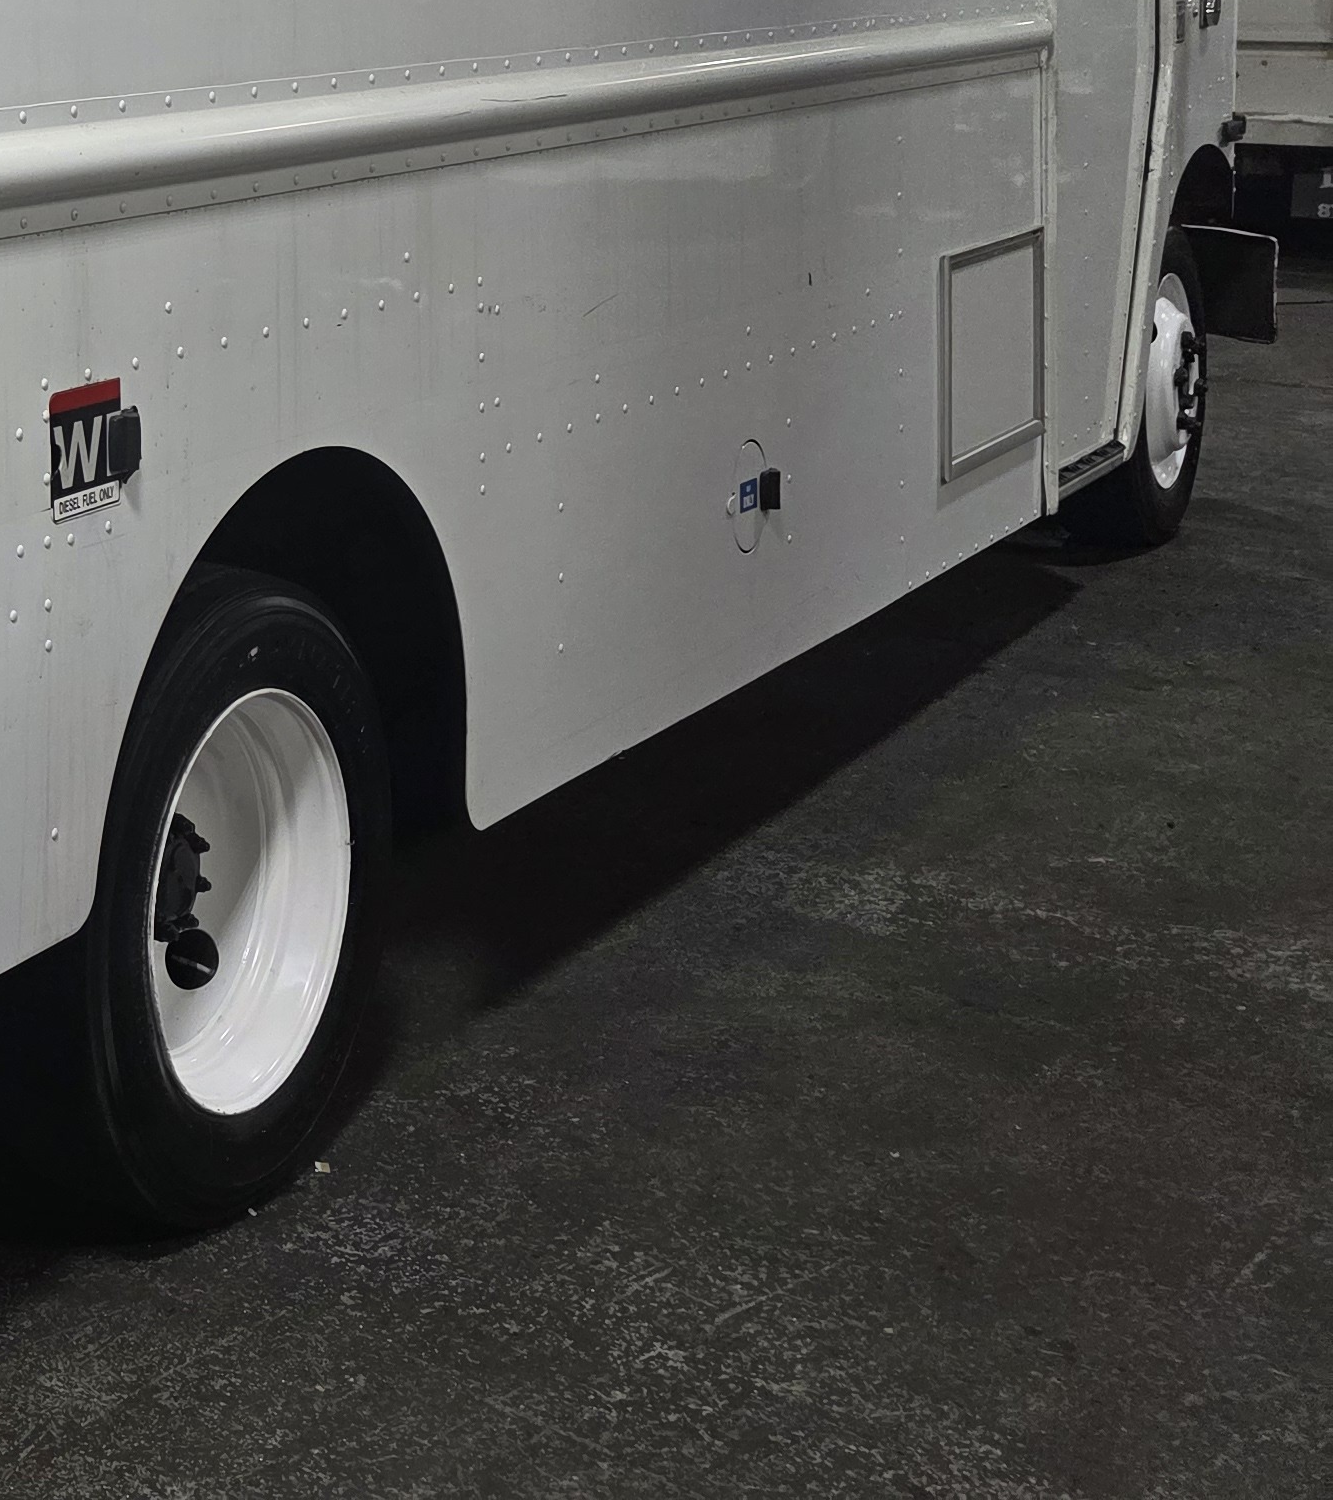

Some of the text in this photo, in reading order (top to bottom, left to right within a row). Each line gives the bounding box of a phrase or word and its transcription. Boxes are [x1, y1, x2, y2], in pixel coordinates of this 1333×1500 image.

[59, 485, 114, 516] DIESEL FUEL ONLY
